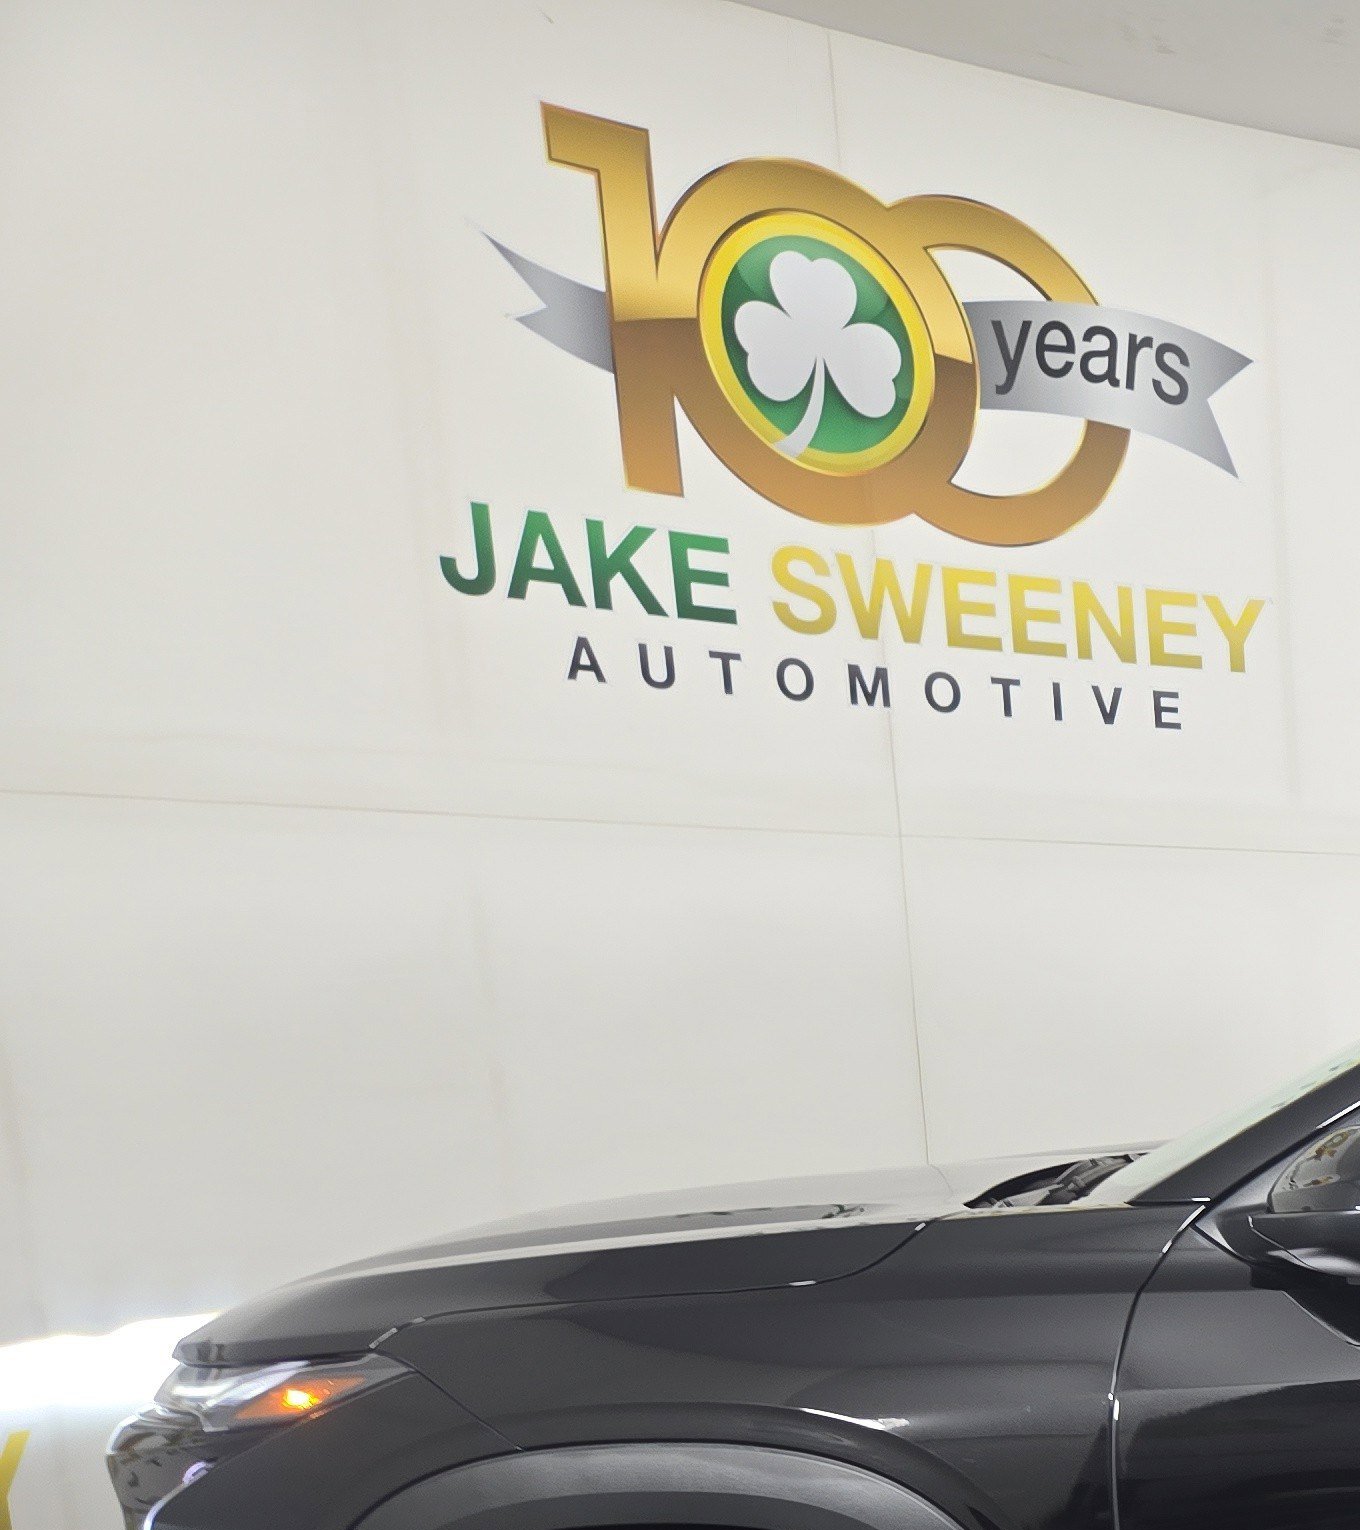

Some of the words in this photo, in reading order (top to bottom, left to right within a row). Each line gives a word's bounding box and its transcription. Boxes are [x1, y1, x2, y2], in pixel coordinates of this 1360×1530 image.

[541, 101, 1131, 547] 100
[989, 317, 1191, 407] years
[440, 502, 739, 626] JAKE
[770, 545, 1266, 675] SWEENEY
[567, 637, 1183, 730] AUTOMOTIVE
